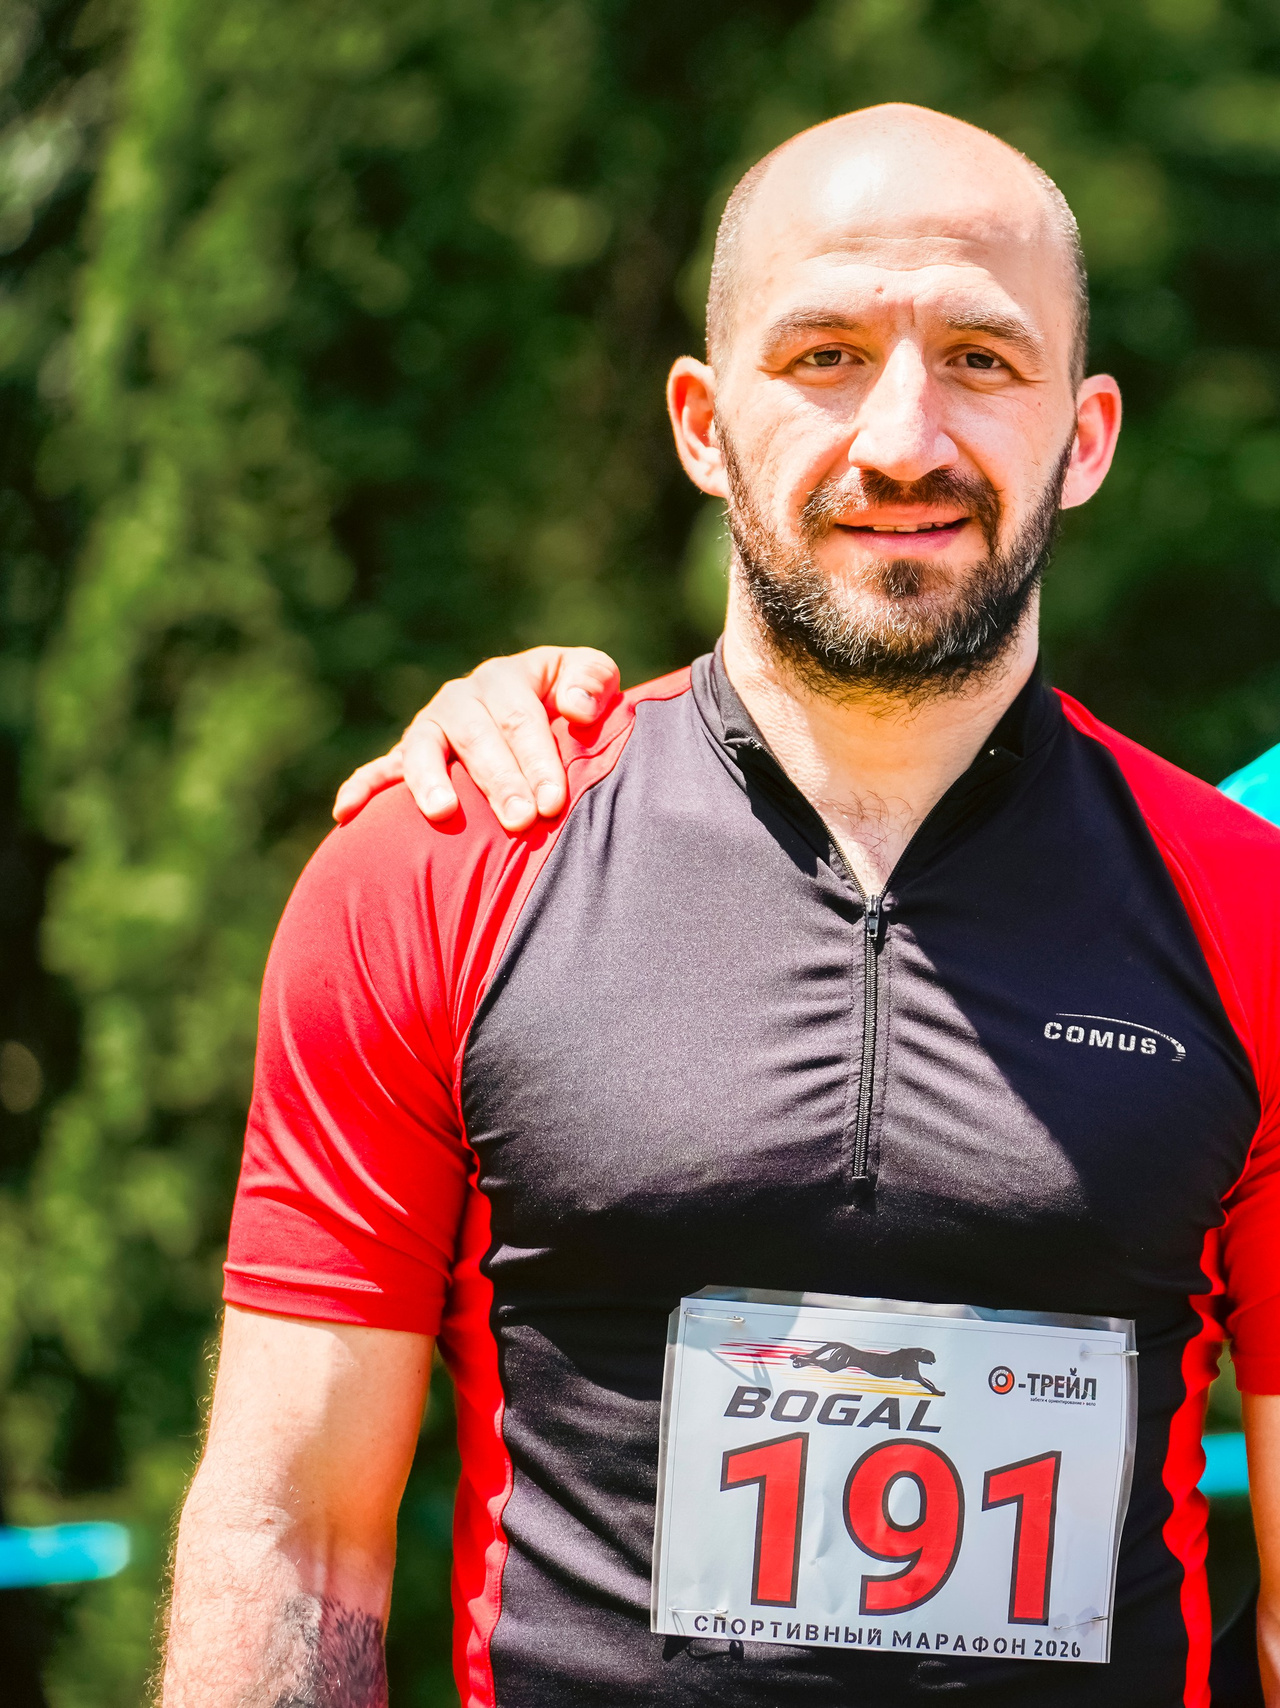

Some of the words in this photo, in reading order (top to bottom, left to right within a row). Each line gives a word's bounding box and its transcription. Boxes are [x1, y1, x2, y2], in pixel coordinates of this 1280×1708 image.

[1043, 1022, 1157, 1055] COMUS
[723, 1385, 943, 1434] BOGAL
[719, 1431, 1062, 1627] 191
[694, 1615, 882, 1646] СПОРТИВНЫЙ
[892, 1629, 1026, 1656] МАРАФОН
[1034, 1639, 1082, 1658] 2026
